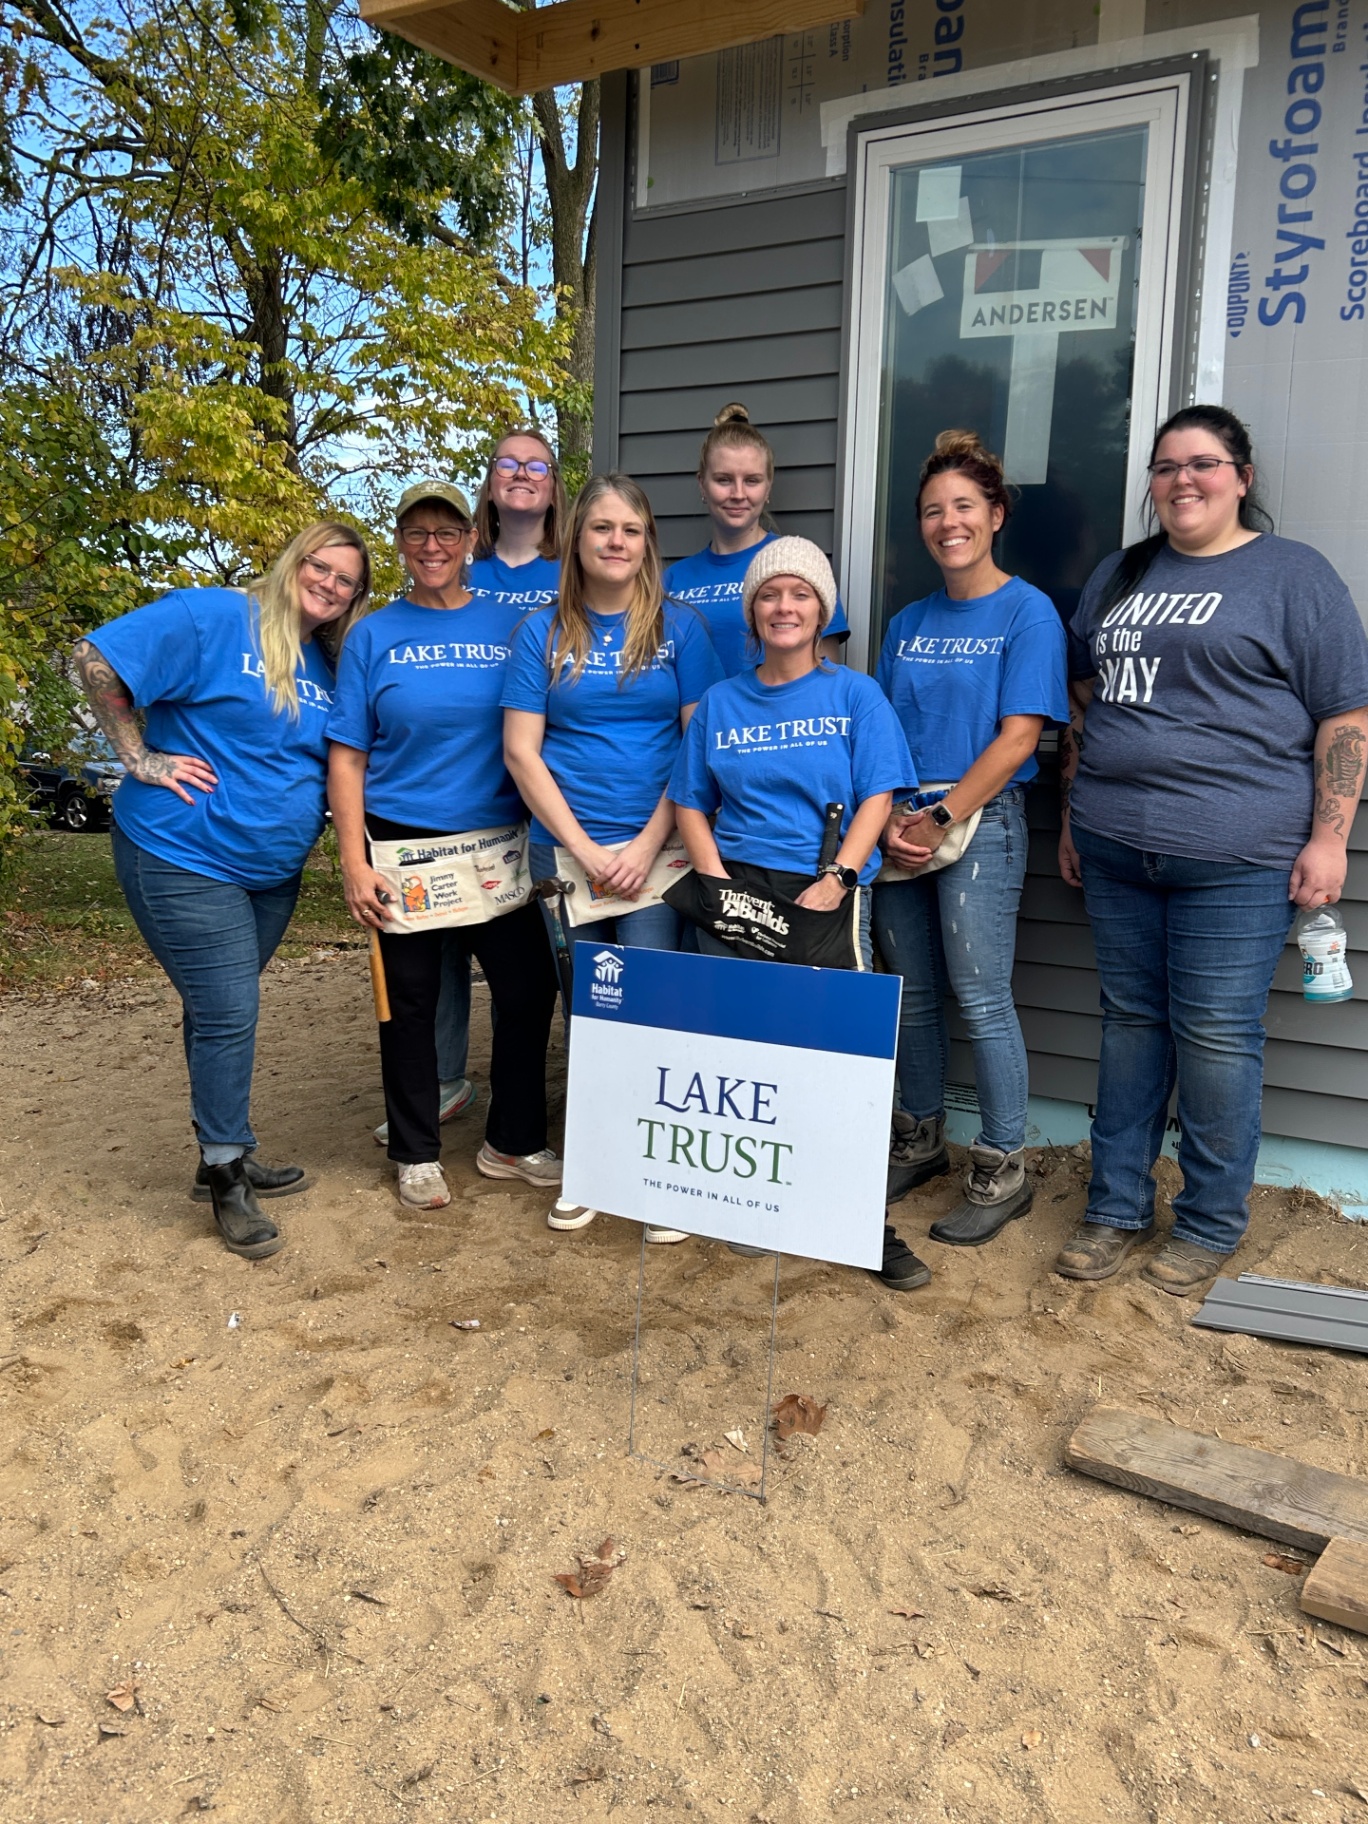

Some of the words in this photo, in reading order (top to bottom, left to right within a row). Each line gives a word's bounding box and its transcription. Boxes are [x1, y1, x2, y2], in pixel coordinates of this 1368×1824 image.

[1258, 0, 1329, 327] Styrofoam
[1226, 262, 1250, 329] DUPONT
[971, 297, 1107, 328] ANDERSEN
[495, 589, 560, 604] TRUS
[1102, 592, 1223, 628] UNITED
[389, 644, 447, 664] LAKE
[941, 636, 1004, 655] TRUST
[1096, 631, 1107, 656] is
[1112, 628, 1142, 652] the
[1099, 657, 1161, 703] WAY
[716, 725, 771, 750] LAKE
[776, 716, 851, 741] TRUST
[752, 745, 778, 753] POWER
[790, 740, 803, 748] ALL
[417, 845, 459, 858] Habitat
[461, 843, 476, 854] for
[430, 873, 454, 884] Jimmy
[431, 881, 458, 891] Carter
[433, 897, 462, 908] Project
[434, 890, 458, 899] Work
[494, 886, 525, 905] MASCO
[719, 889, 772, 915] Thrivent
[740, 901, 790, 935] Builds
[592, 983, 622, 997] Habitat
[655, 1066, 778, 1125] LAKE
[637, 1118, 793, 1185] TRUST
[643, 1178, 662, 1189] THE
[666, 1183, 703, 1197] POWER
[707, 1191, 718, 1200] IN
[722, 1195, 742, 1206] ALL
[746, 1199, 760, 1208] OF
[765, 1203, 780, 1212] US
